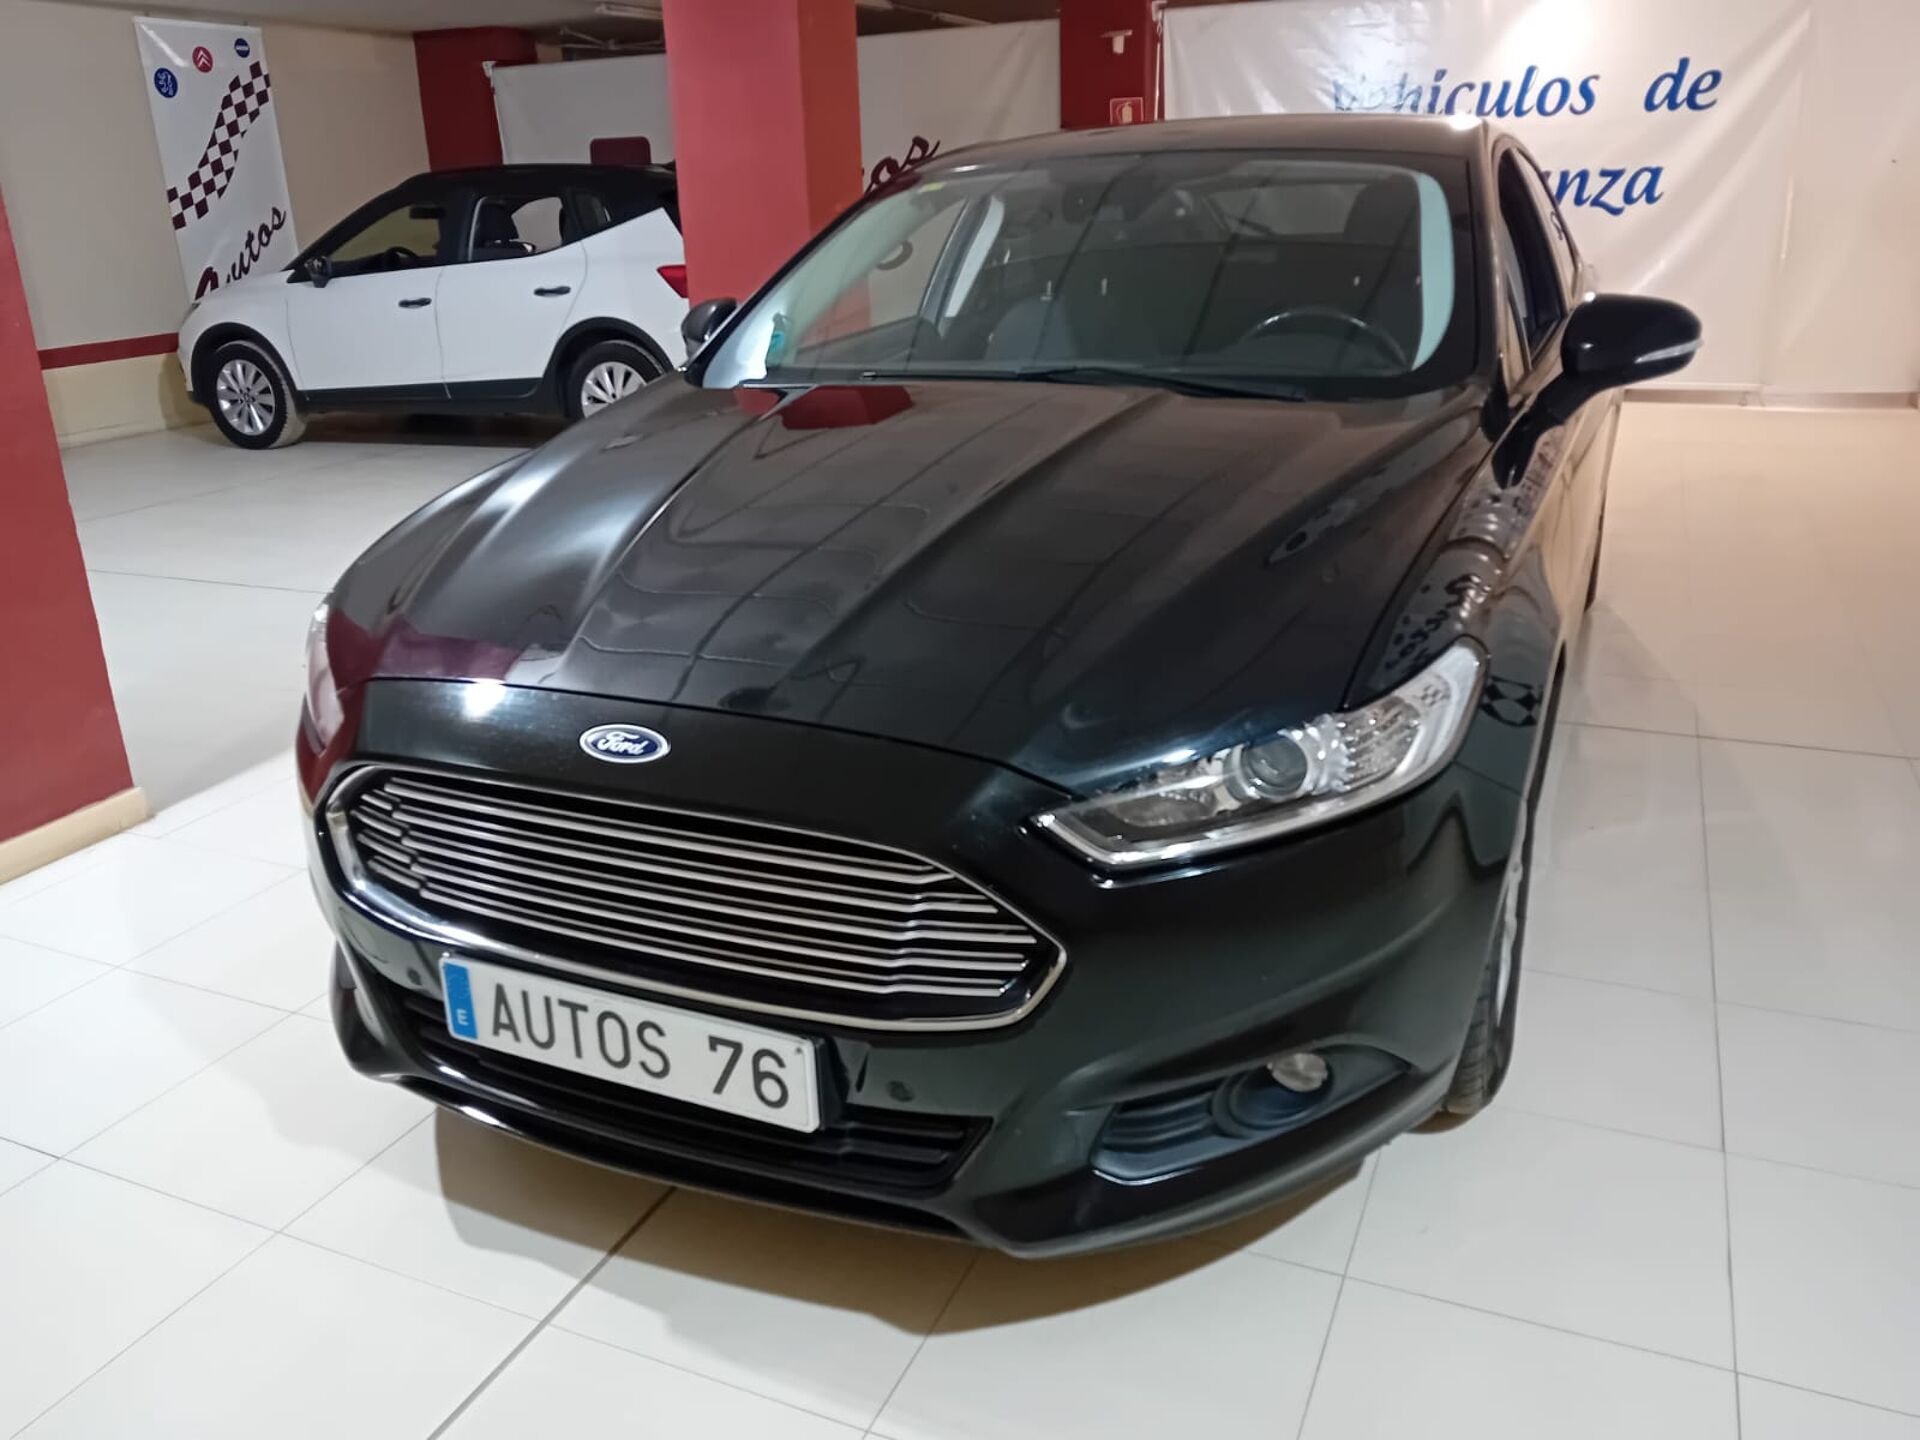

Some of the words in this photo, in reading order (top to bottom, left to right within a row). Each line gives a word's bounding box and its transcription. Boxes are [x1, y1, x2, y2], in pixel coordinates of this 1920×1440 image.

[1644, 57, 1722, 112] de
[1541, 166, 1664, 216] nza
[597, 731, 649, 755] Ford
[457, 1008, 468, 1026] E
[492, 983, 671, 1080] AUTOS
[708, 1034, 790, 1110] 76
